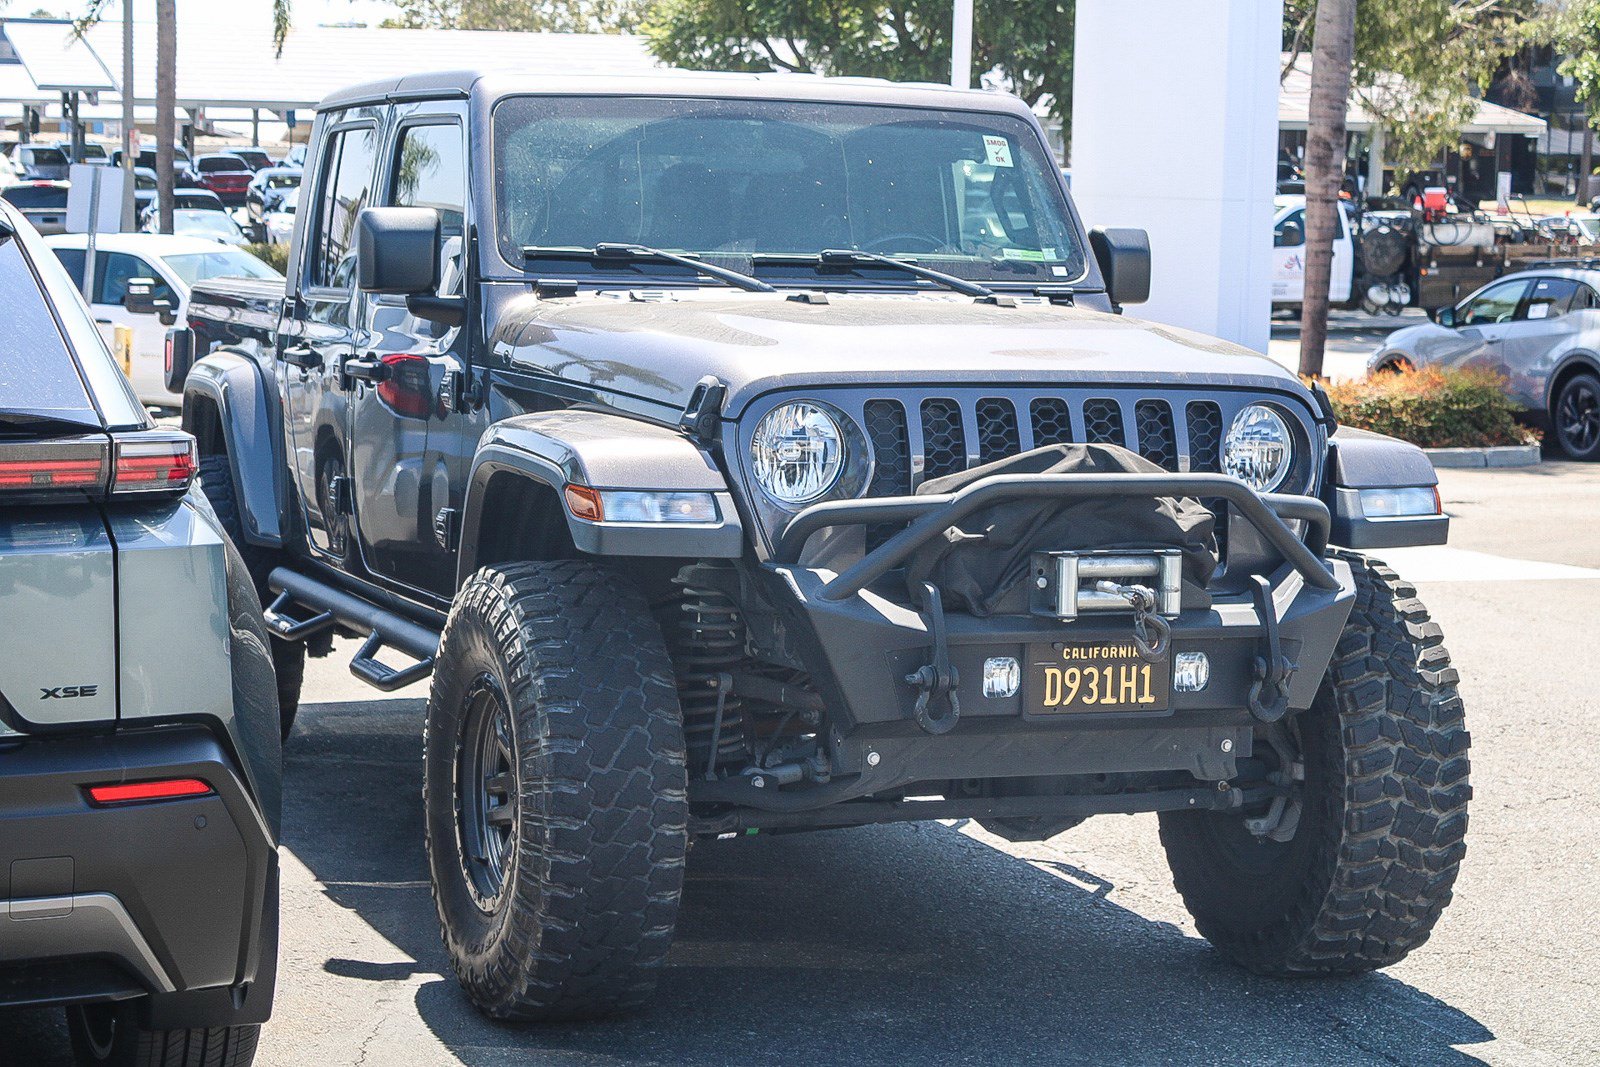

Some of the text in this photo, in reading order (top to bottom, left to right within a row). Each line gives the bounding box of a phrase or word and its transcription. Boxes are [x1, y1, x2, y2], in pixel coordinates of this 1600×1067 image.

[986, 139, 1007, 147] SMOG
[1063, 646, 1140, 660] CALIFORNIA
[39, 684, 99, 700] XSE
[1043, 664, 1156, 706] D931H1
